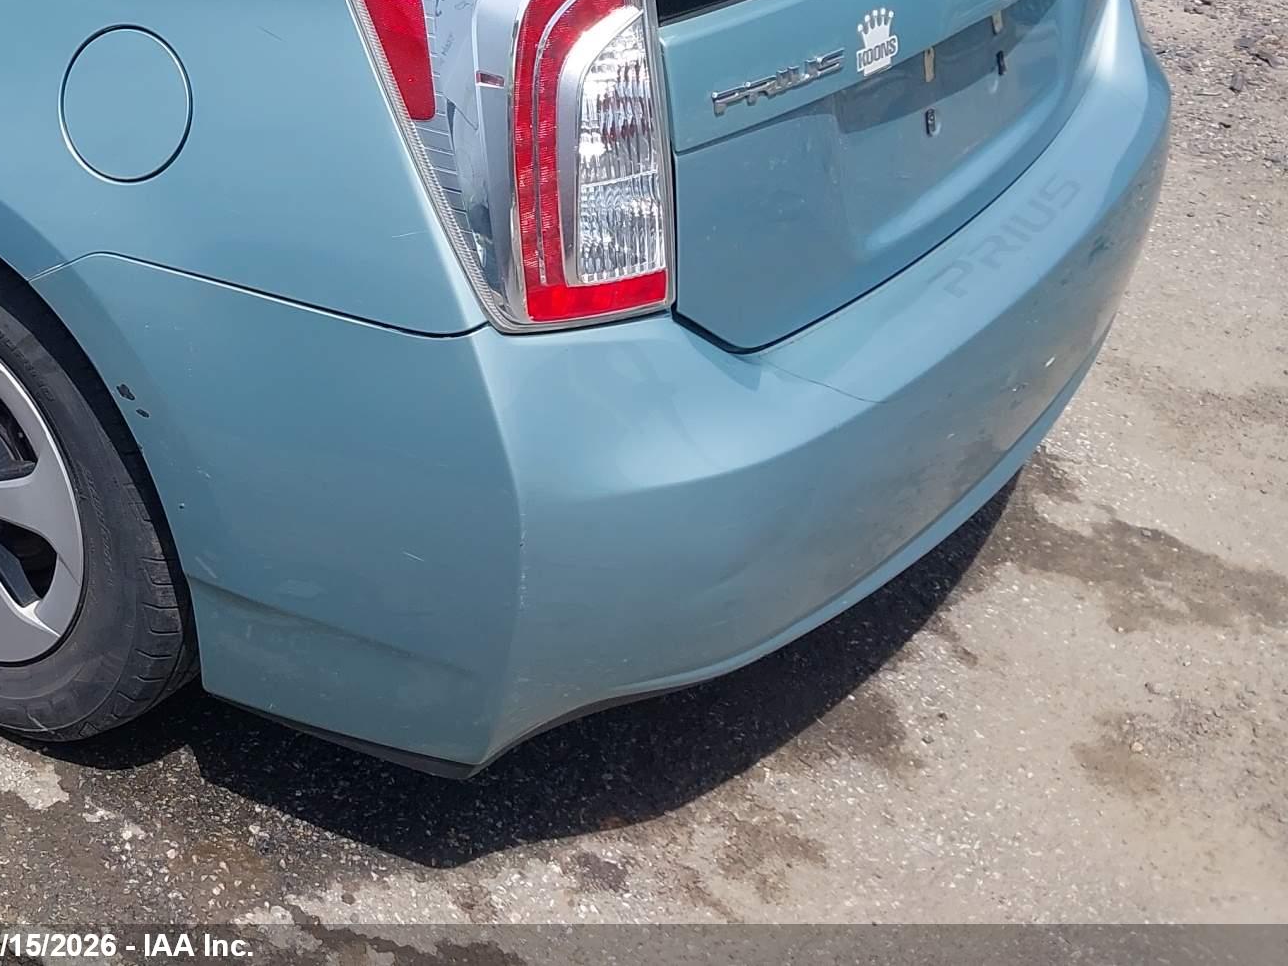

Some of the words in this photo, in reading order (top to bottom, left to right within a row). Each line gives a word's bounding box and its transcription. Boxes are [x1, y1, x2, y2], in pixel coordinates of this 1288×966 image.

[711, 47, 845, 117] PRIUS
[857, 37, 897, 70] KOONS
[926, 173, 1081, 298] PRIUS
